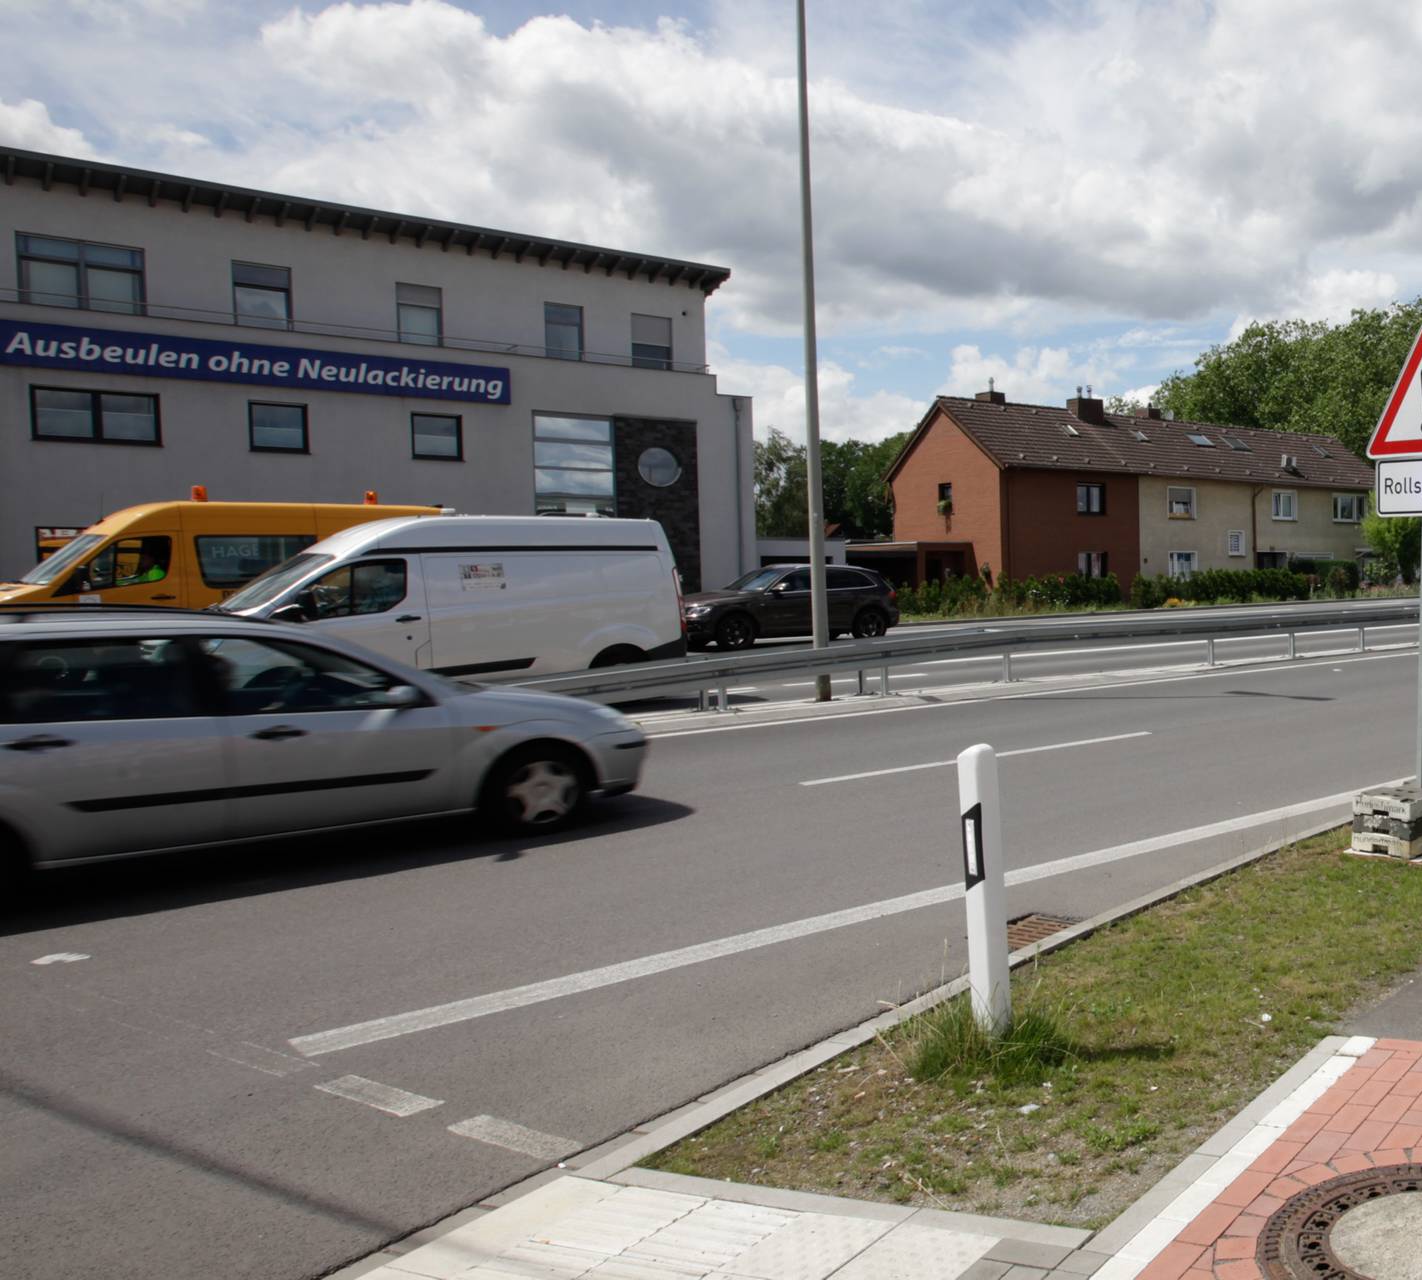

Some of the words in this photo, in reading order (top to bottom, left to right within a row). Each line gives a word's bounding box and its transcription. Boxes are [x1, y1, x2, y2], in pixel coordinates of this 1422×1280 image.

[5, 331, 200, 369] Ausbeulen
[208, 351, 290, 376] ohne
[297, 358, 504, 399] Neulackierung
